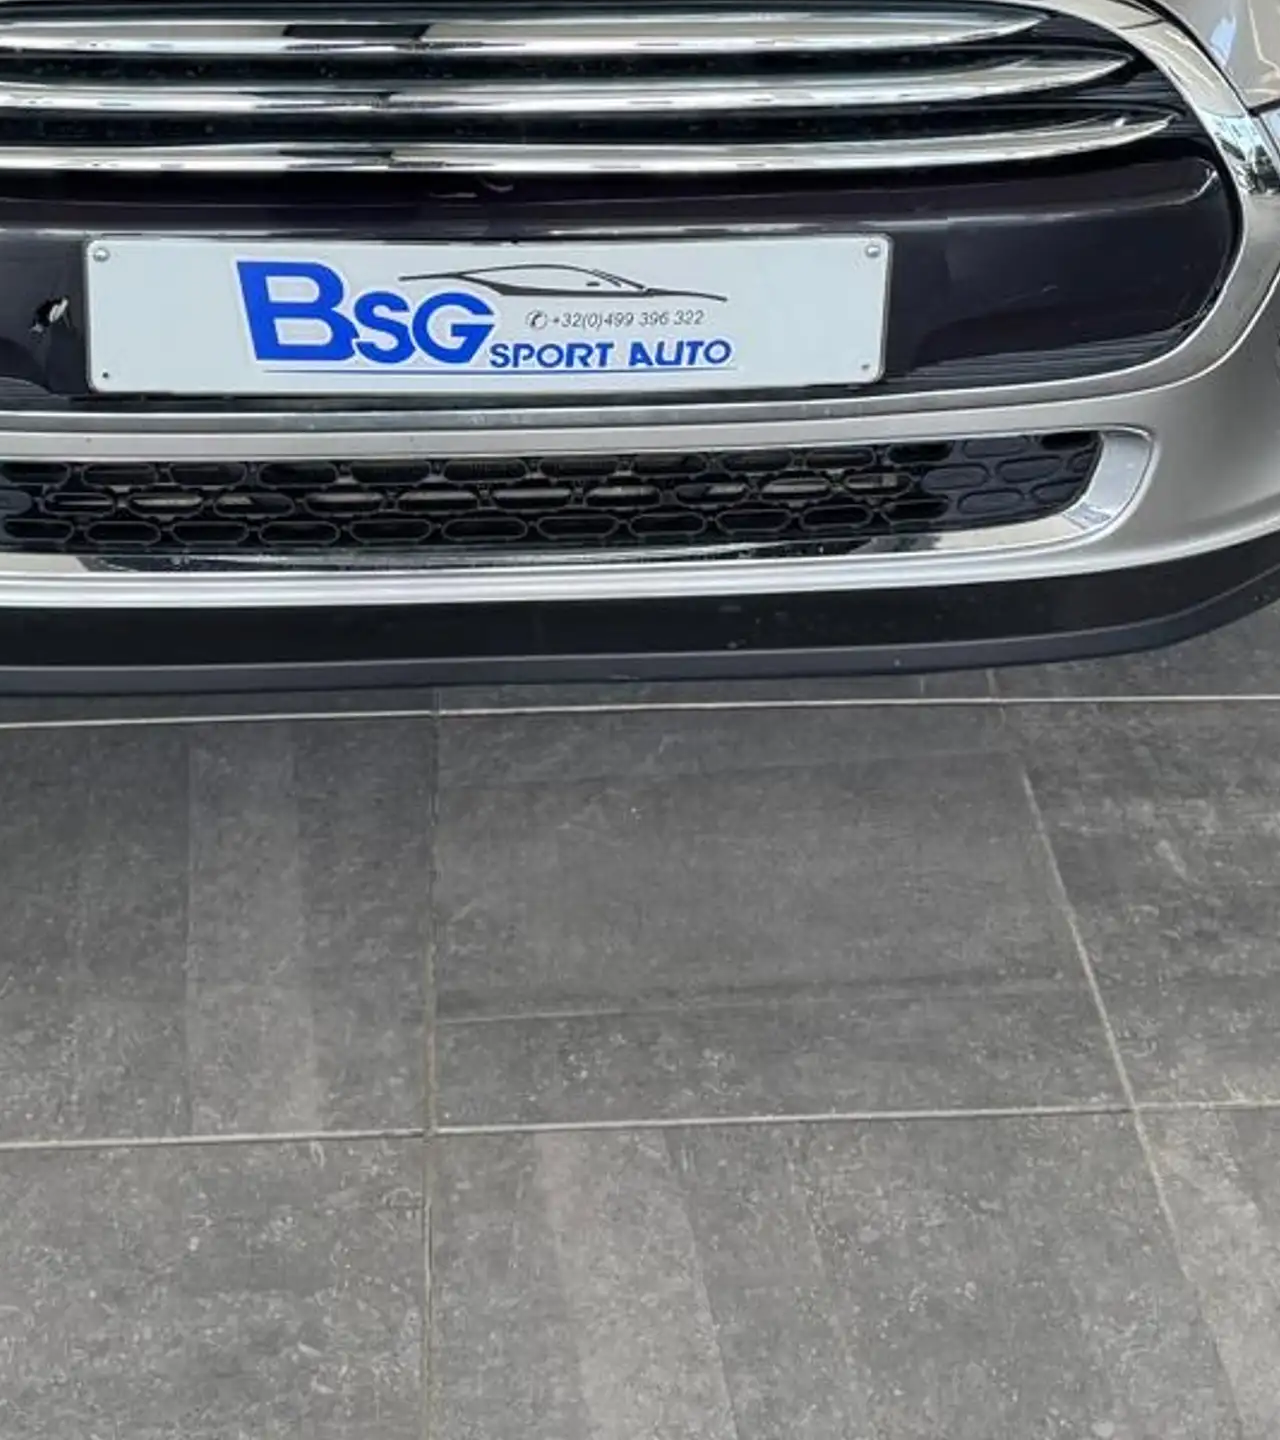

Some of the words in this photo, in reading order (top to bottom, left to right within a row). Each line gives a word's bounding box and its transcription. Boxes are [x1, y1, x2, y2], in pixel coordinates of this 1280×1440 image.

[236, 261, 496, 365] BSG
[489, 342, 615, 369] SPORT
[628, 338, 732, 367] AUTO
[552, 312, 635, 332] +32(0)499
[638, 311, 670, 327] 396
[673, 309, 705, 326] 322
